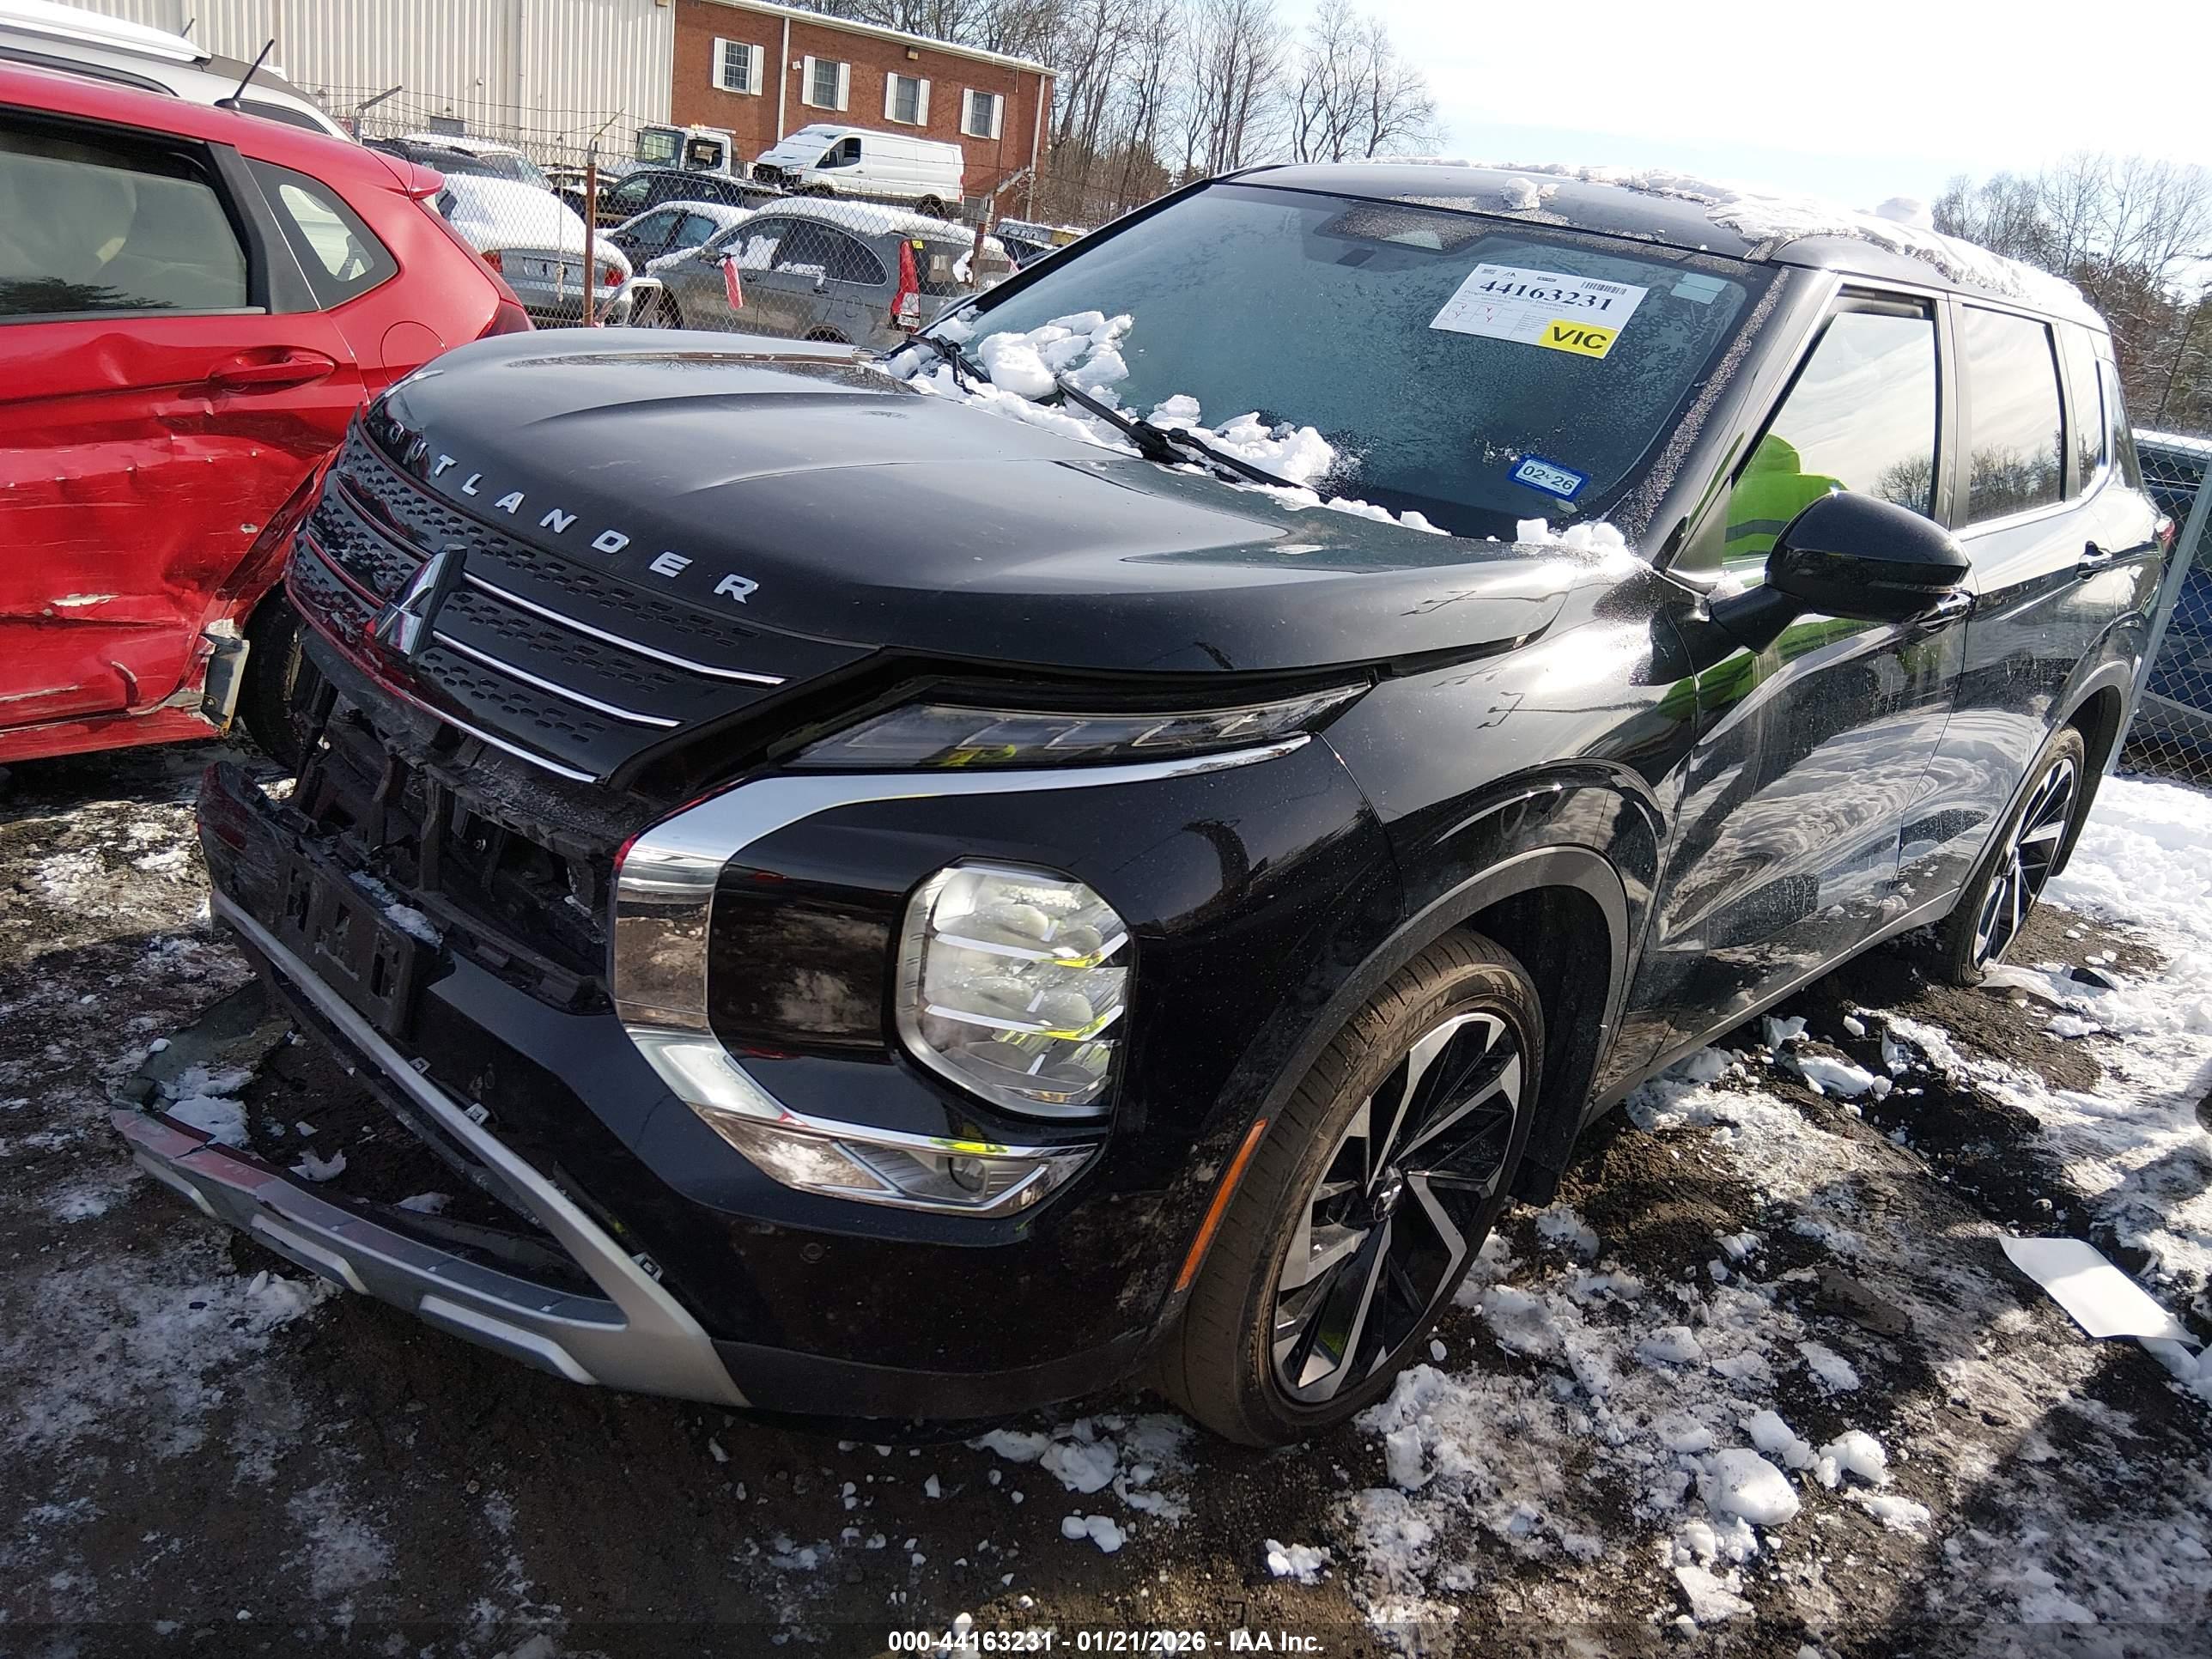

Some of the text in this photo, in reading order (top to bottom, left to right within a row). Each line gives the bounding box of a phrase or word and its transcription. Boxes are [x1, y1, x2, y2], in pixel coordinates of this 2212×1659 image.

[1479, 279, 1614, 311] 44163231
[1553, 325, 1607, 349] VIC
[1522, 465, 1547, 480] 02
[1551, 475, 1575, 490] 26
